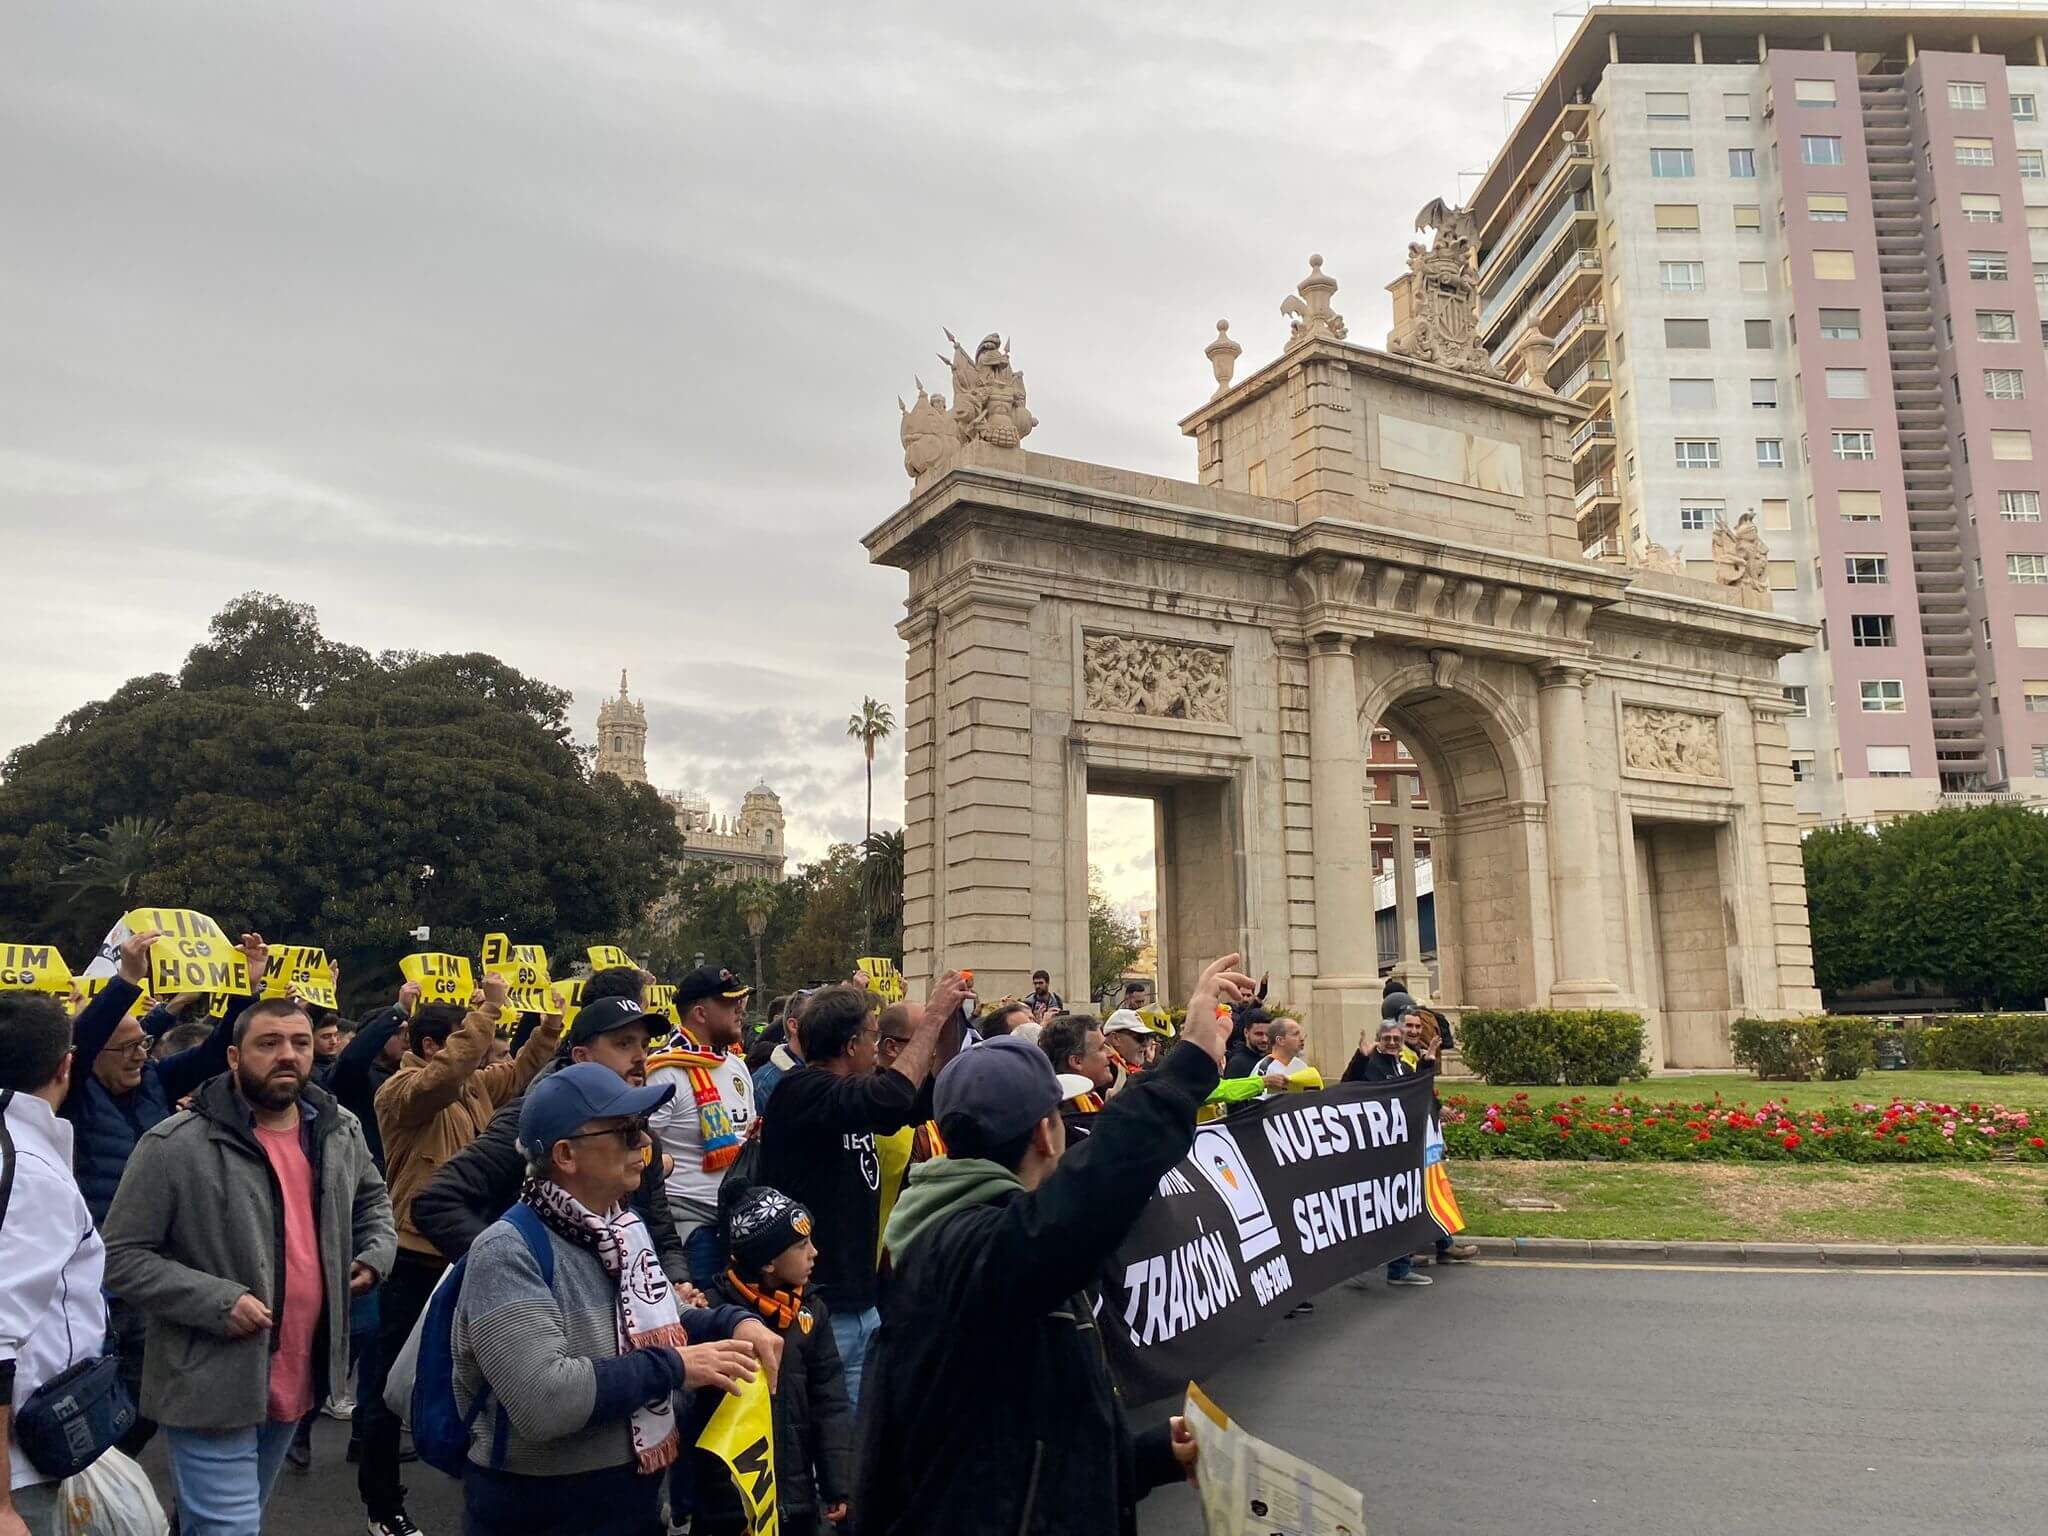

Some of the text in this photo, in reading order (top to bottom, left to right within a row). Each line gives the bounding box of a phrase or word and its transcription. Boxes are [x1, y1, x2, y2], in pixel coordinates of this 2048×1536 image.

[153, 911, 217, 938] LIM
[6, 946, 49, 969] IM
[421, 955, 461, 978] LIM
[159, 959, 248, 989] HOME
[305, 986, 333, 1004] ME
[1262, 1098, 1409, 1167] NUESTRA
[1293, 1168, 1423, 1255] SENTENCIA
[1123, 1216, 1242, 1348] TRAICIÓN
